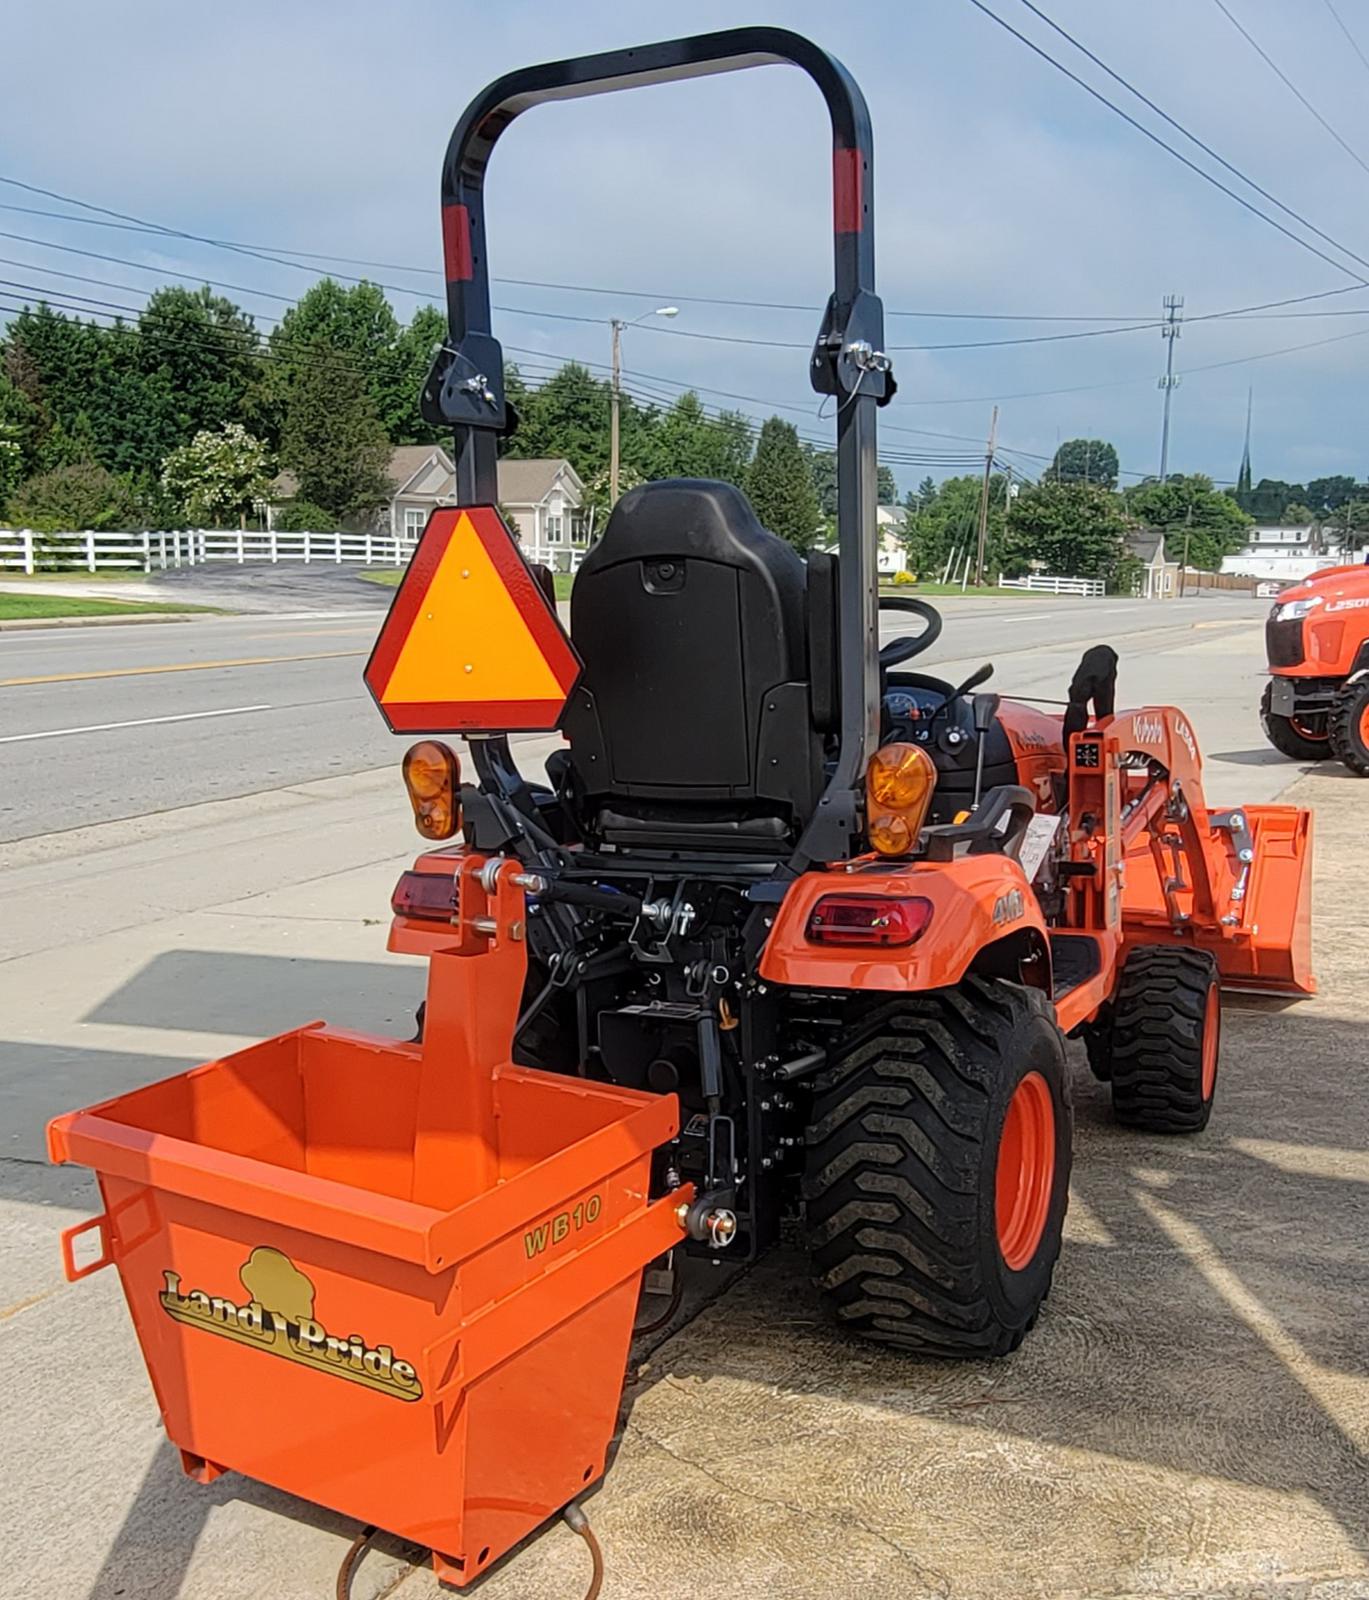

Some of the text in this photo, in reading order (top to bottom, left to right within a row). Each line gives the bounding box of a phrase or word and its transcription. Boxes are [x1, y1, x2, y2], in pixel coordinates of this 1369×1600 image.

[992, 887, 1025, 926] 4WD
[524, 1194, 602, 1259] WB10
[162, 1270, 416, 1387] Land Pride
